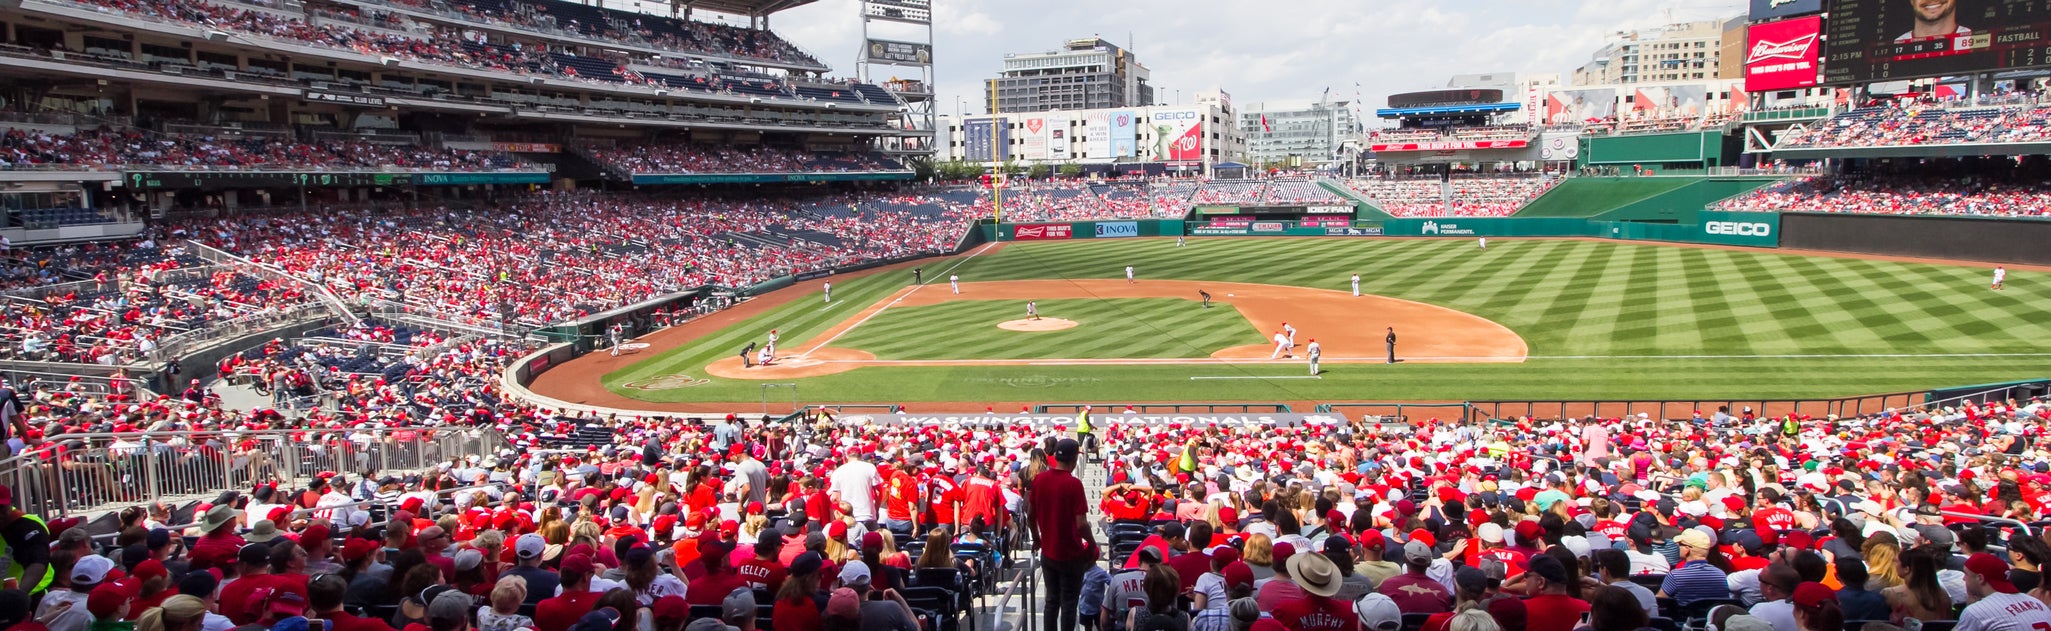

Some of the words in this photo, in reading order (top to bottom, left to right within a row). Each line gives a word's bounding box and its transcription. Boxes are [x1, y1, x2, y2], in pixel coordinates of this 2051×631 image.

[1962, 39, 1974, 47] 89
[1998, 32, 2040, 43] FASTBALL
[1752, 43, 1809, 57] Budweiser
[1765, 64, 1782, 73] BUD'S
[1796, 61, 1811, 69] YOU.
[1155, 111, 1195, 120] GEICO
[1107, 225, 1136, 234] INOVA
[1705, 221, 1770, 236] GEICO
[1105, 416, 1276, 424] NATIONALS
[1766, 513, 1792, 523] HARPER
[740, 564, 770, 578] KELLEY
[2005, 601, 2044, 616] FRANCO
[1300, 613, 1345, 628] MURPHY
